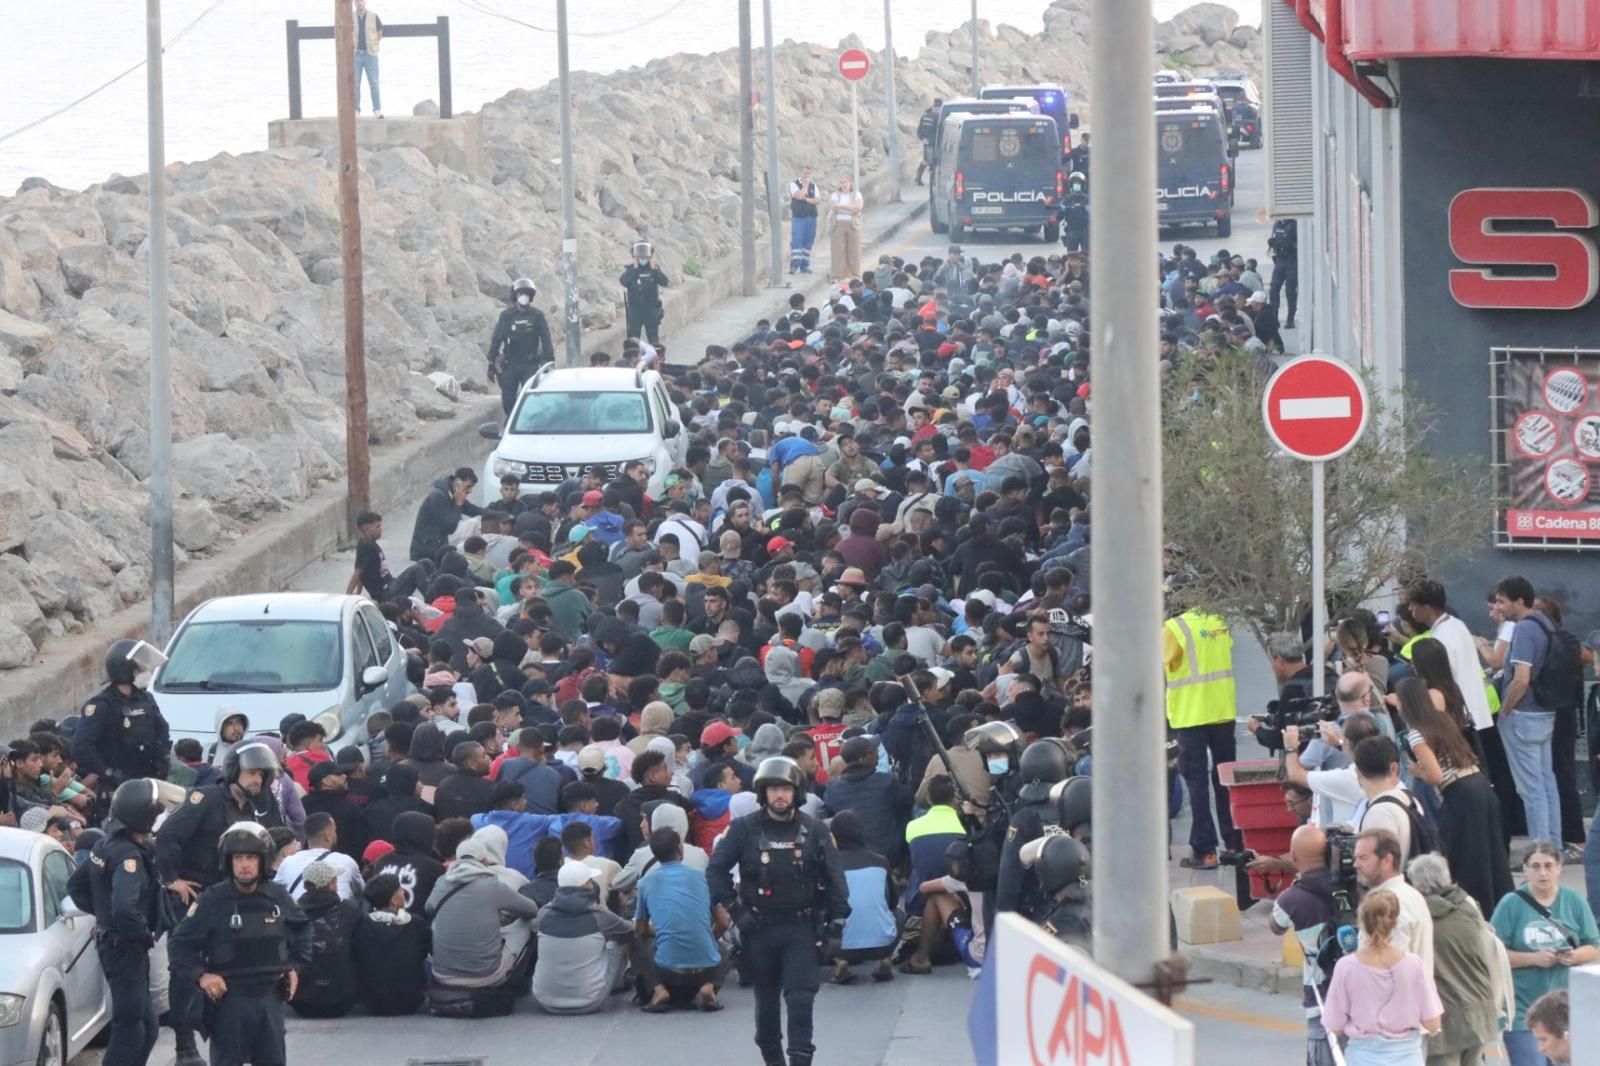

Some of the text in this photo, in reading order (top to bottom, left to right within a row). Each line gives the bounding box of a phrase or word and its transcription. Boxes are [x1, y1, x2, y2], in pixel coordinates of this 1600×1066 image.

[1154, 184, 1211, 199] OLICÍA
[1448, 187, 1599, 310] S
[1535, 516, 1587, 530] Cadena
